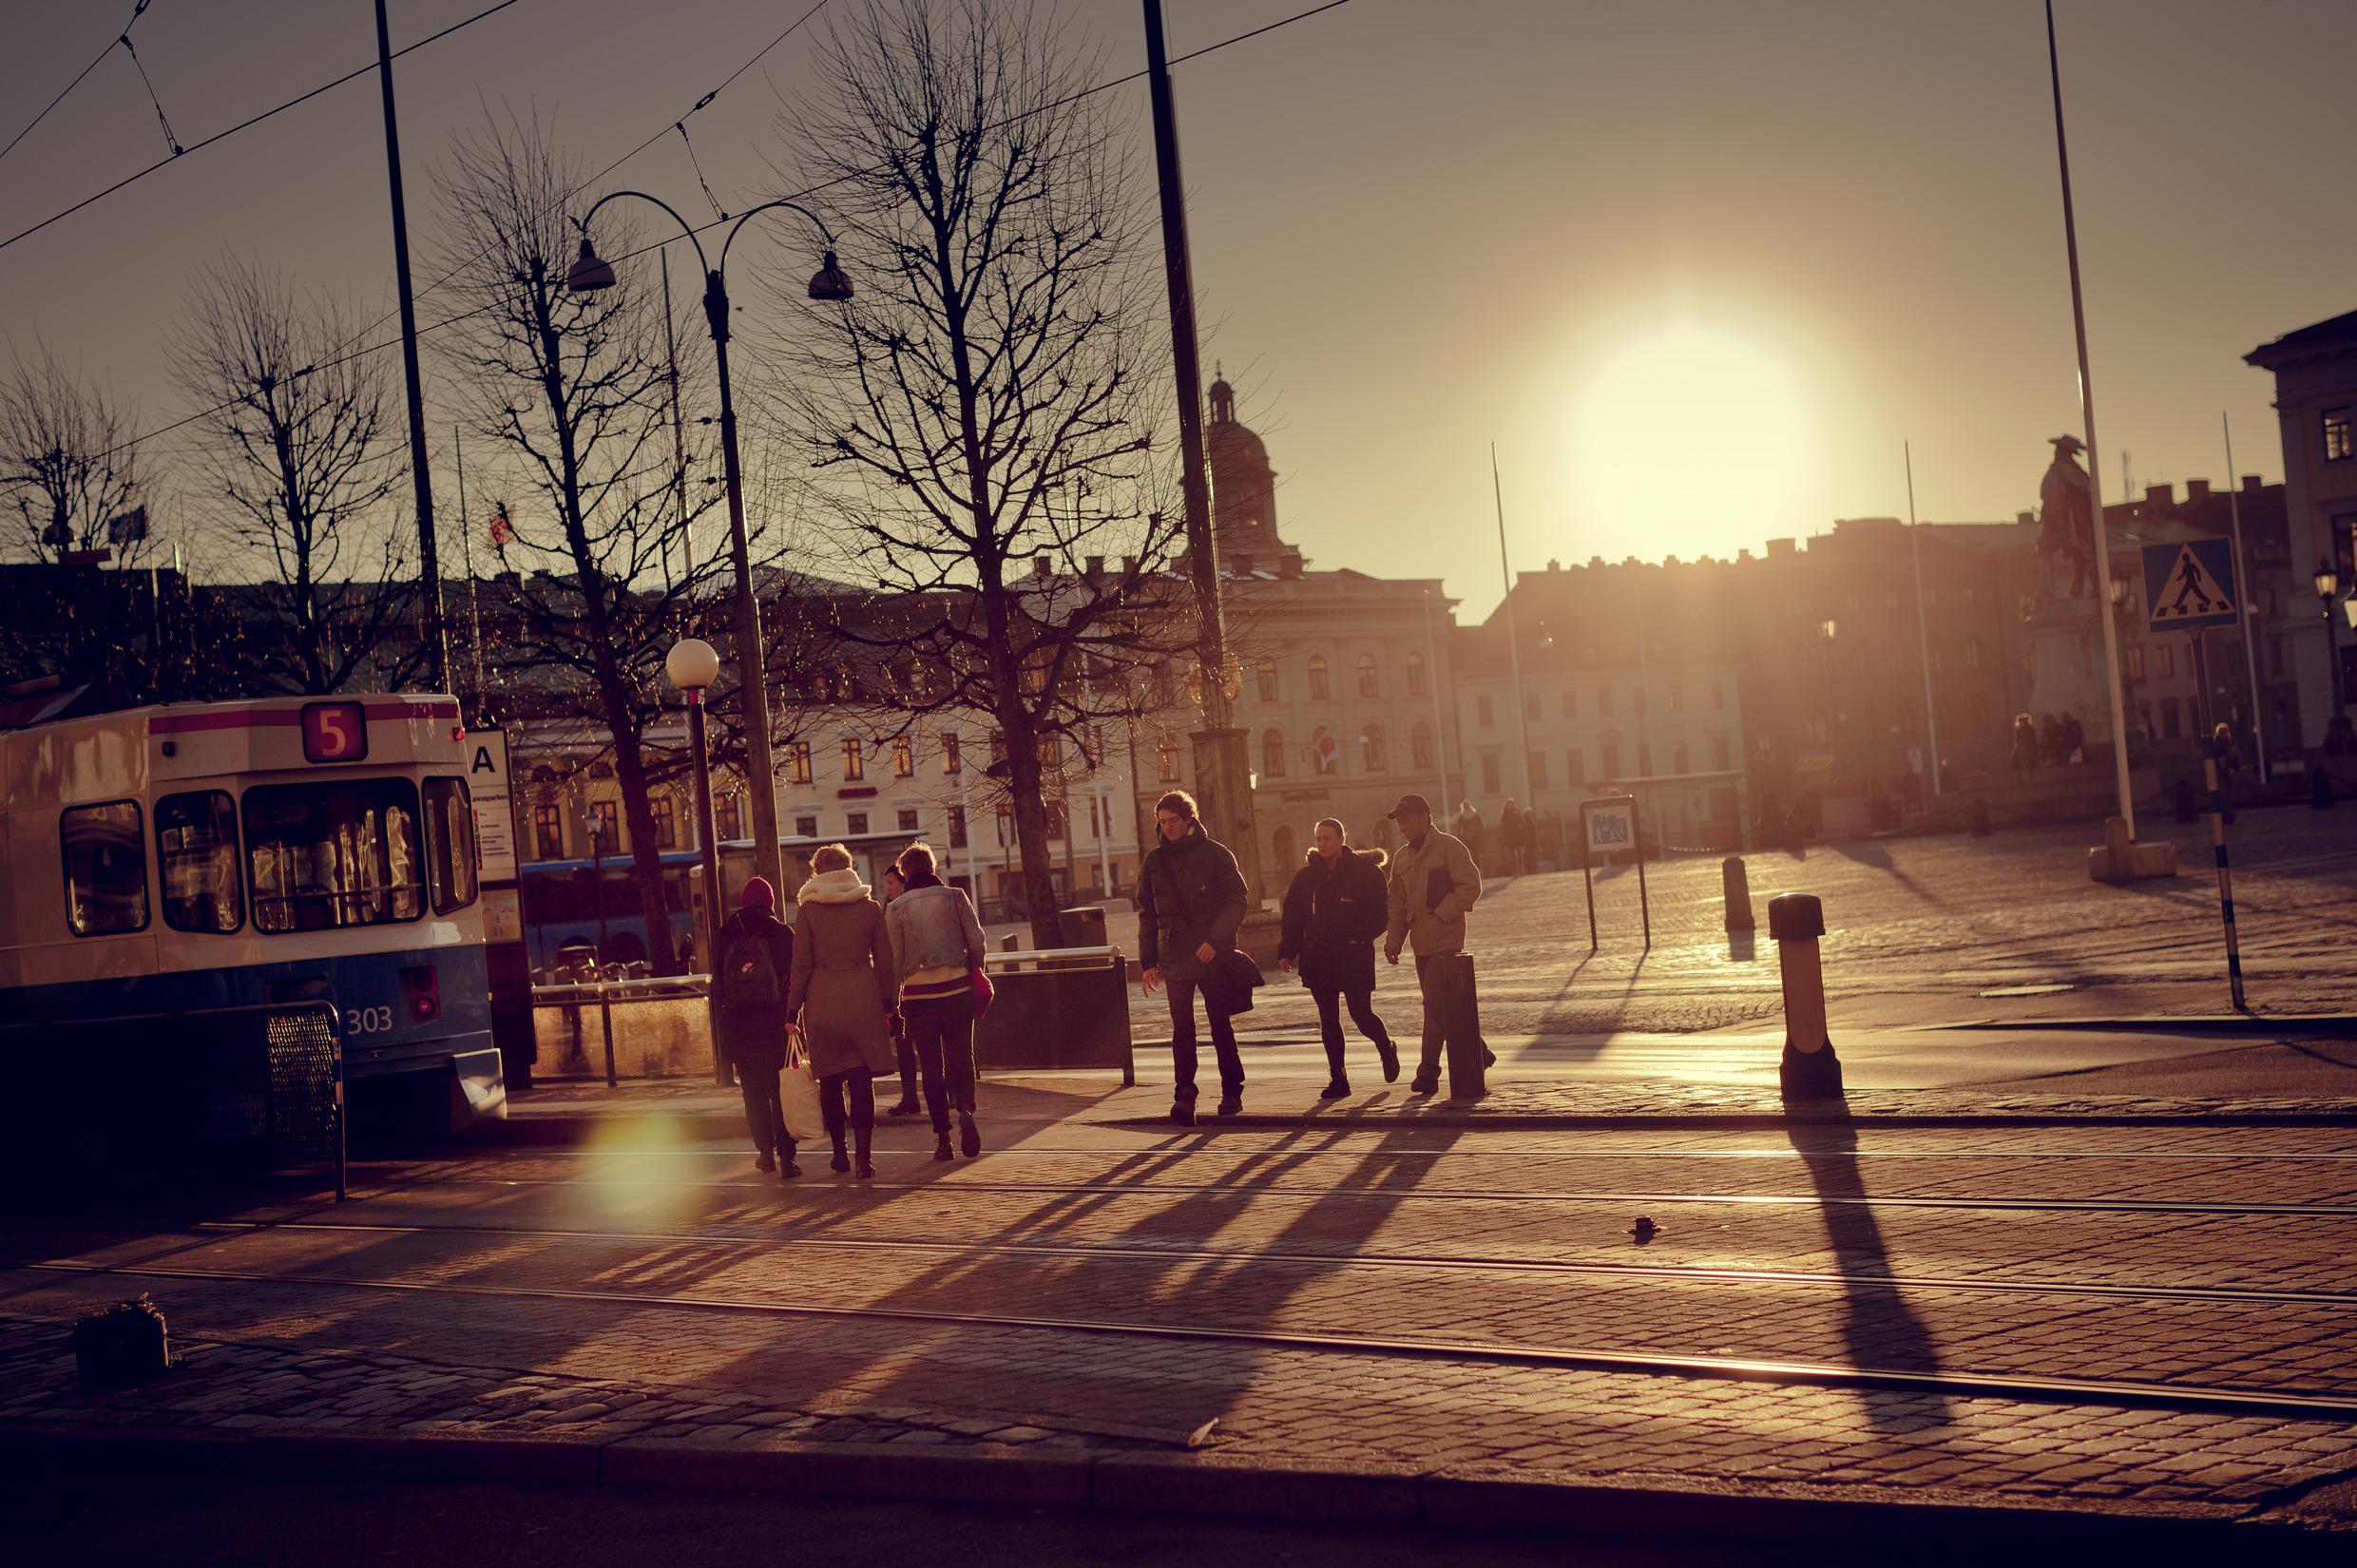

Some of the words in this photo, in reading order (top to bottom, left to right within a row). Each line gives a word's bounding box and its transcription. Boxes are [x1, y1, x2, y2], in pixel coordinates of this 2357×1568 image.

[319, 709, 346, 756] 5
[471, 746, 496, 774] A
[346, 1005, 393, 1035] 303
